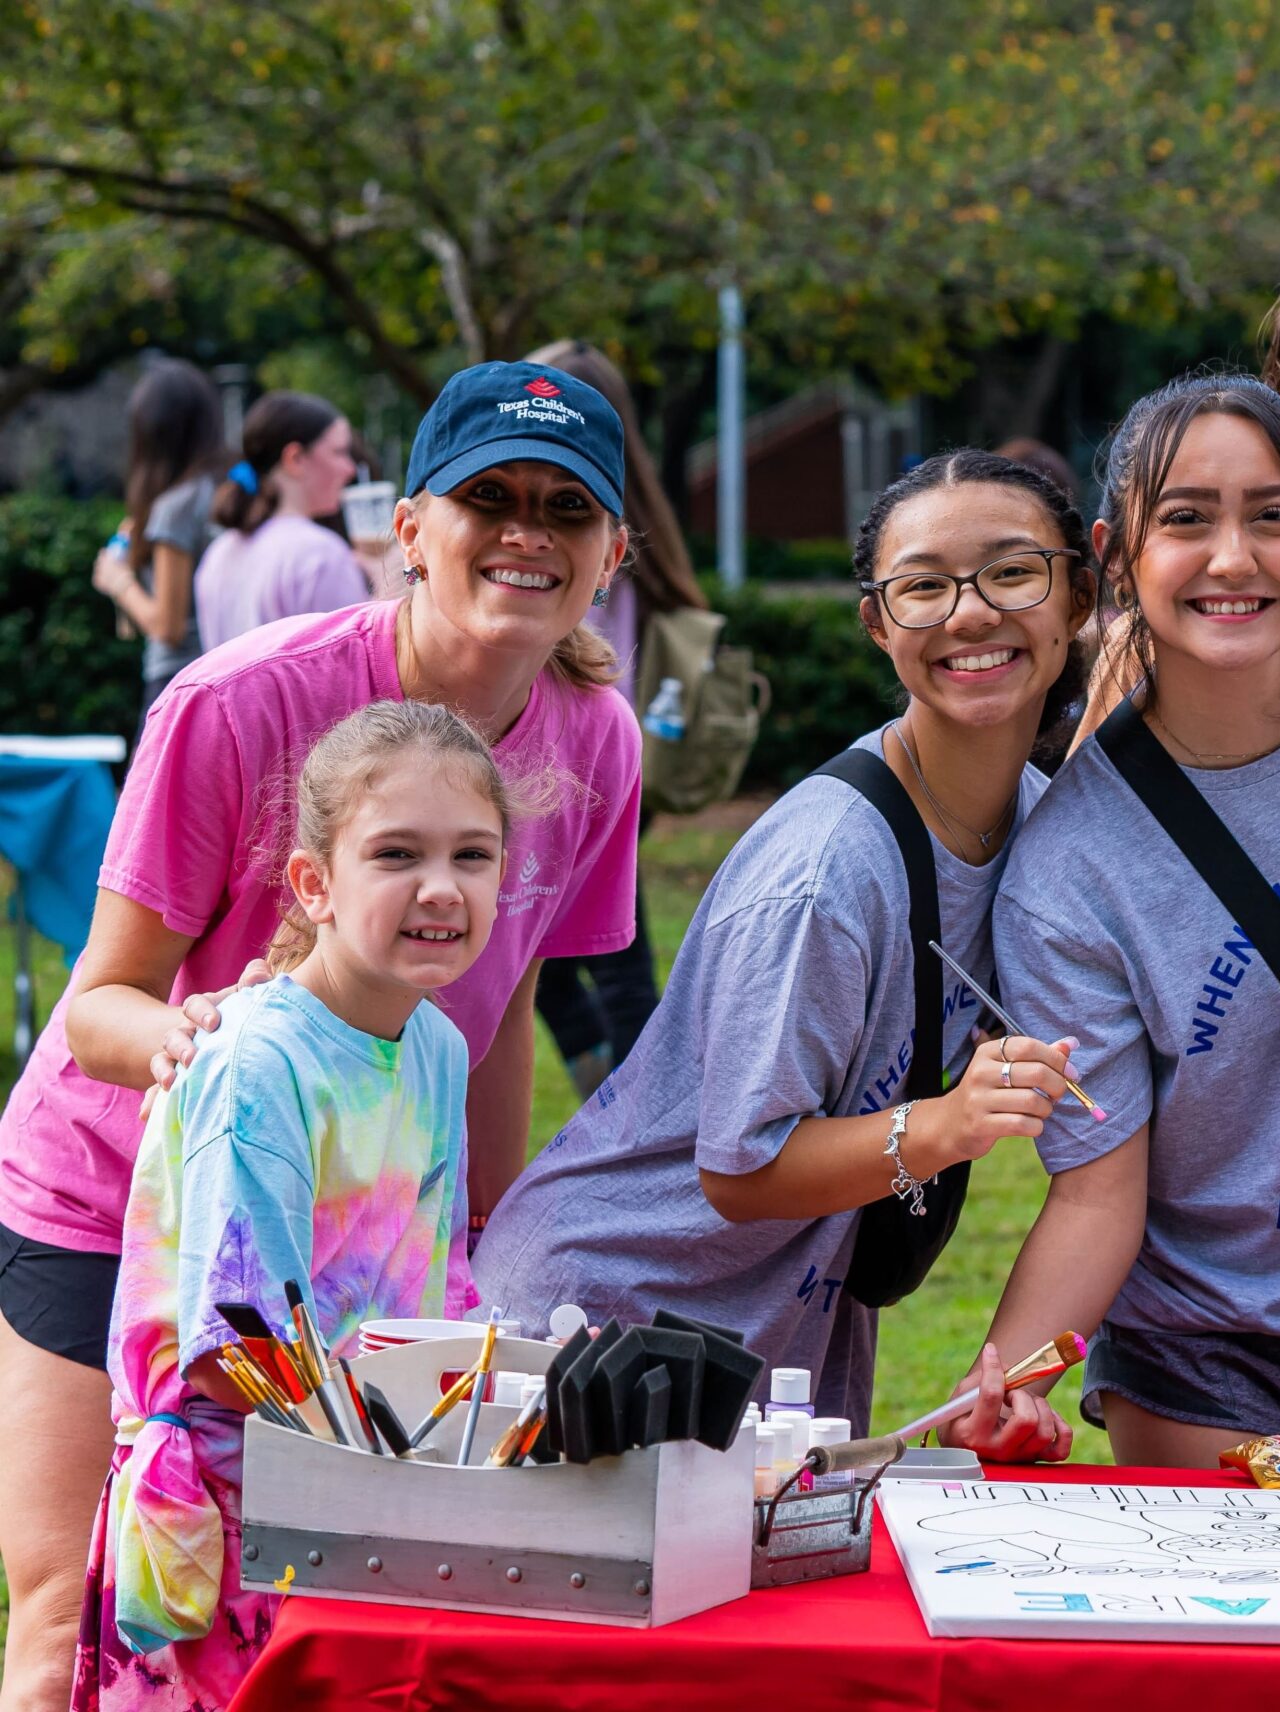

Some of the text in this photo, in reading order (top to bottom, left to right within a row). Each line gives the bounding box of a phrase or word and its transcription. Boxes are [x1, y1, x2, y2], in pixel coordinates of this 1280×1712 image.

[497, 399, 529, 413] Texas
[516, 408, 567, 424] Hospital
[1012, 1591, 1271, 1616] ARE
